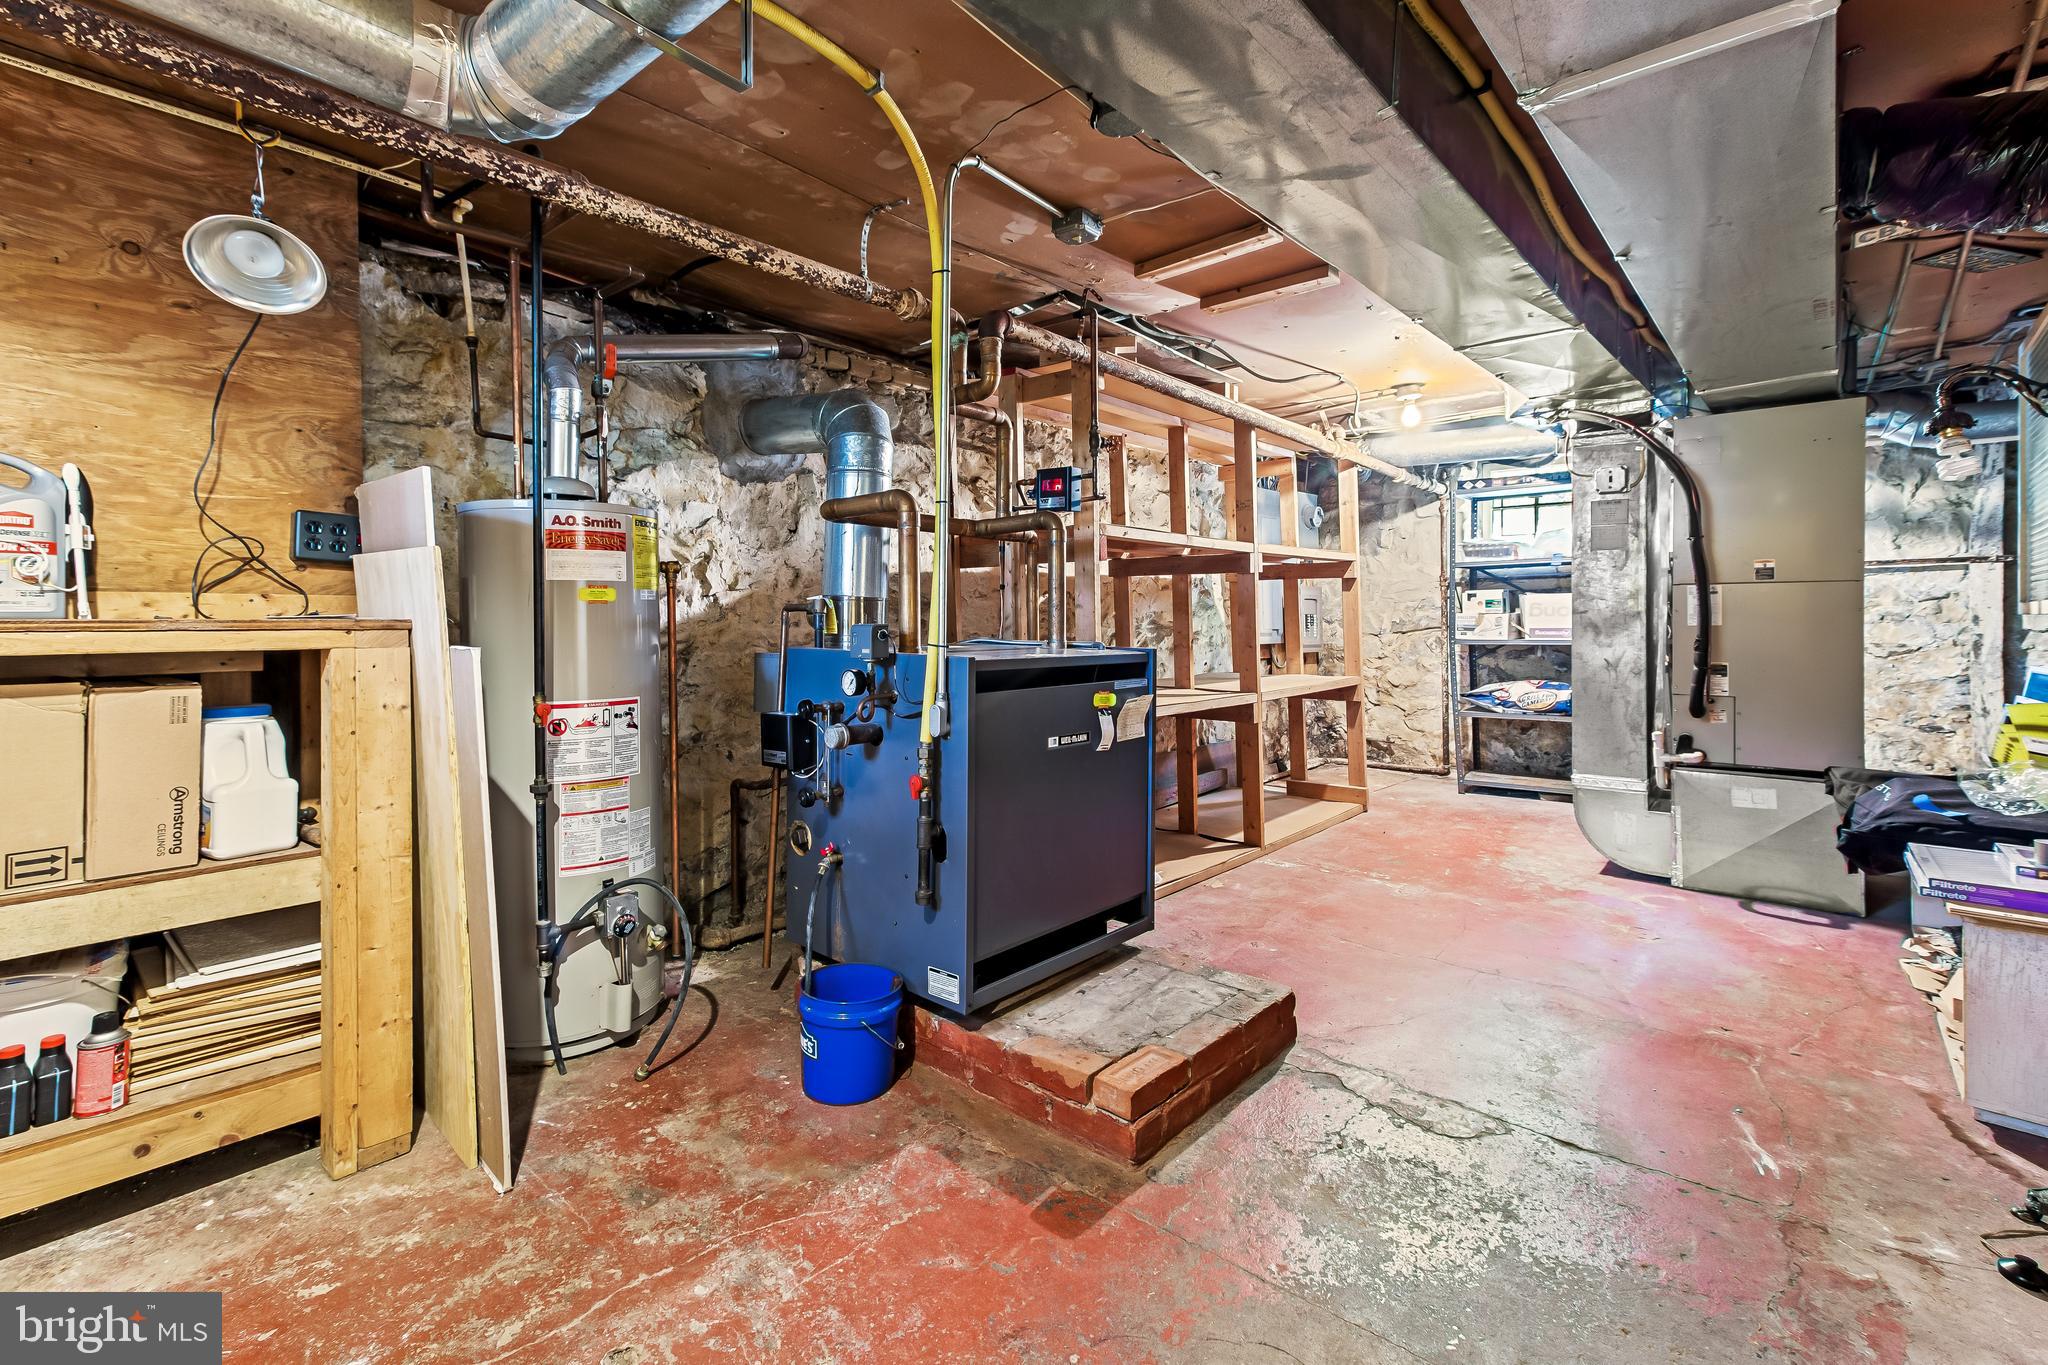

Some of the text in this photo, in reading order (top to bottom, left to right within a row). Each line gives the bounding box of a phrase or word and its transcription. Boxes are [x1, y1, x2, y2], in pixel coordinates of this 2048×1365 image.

[582, 515, 622, 529] Smith
[168, 786, 190, 855] Armstrong
[156, 823, 167, 857] CEILINGS
[1930, 879, 1977, 892] Filtrete
[1921, 888, 1967, 901] Filtrete
